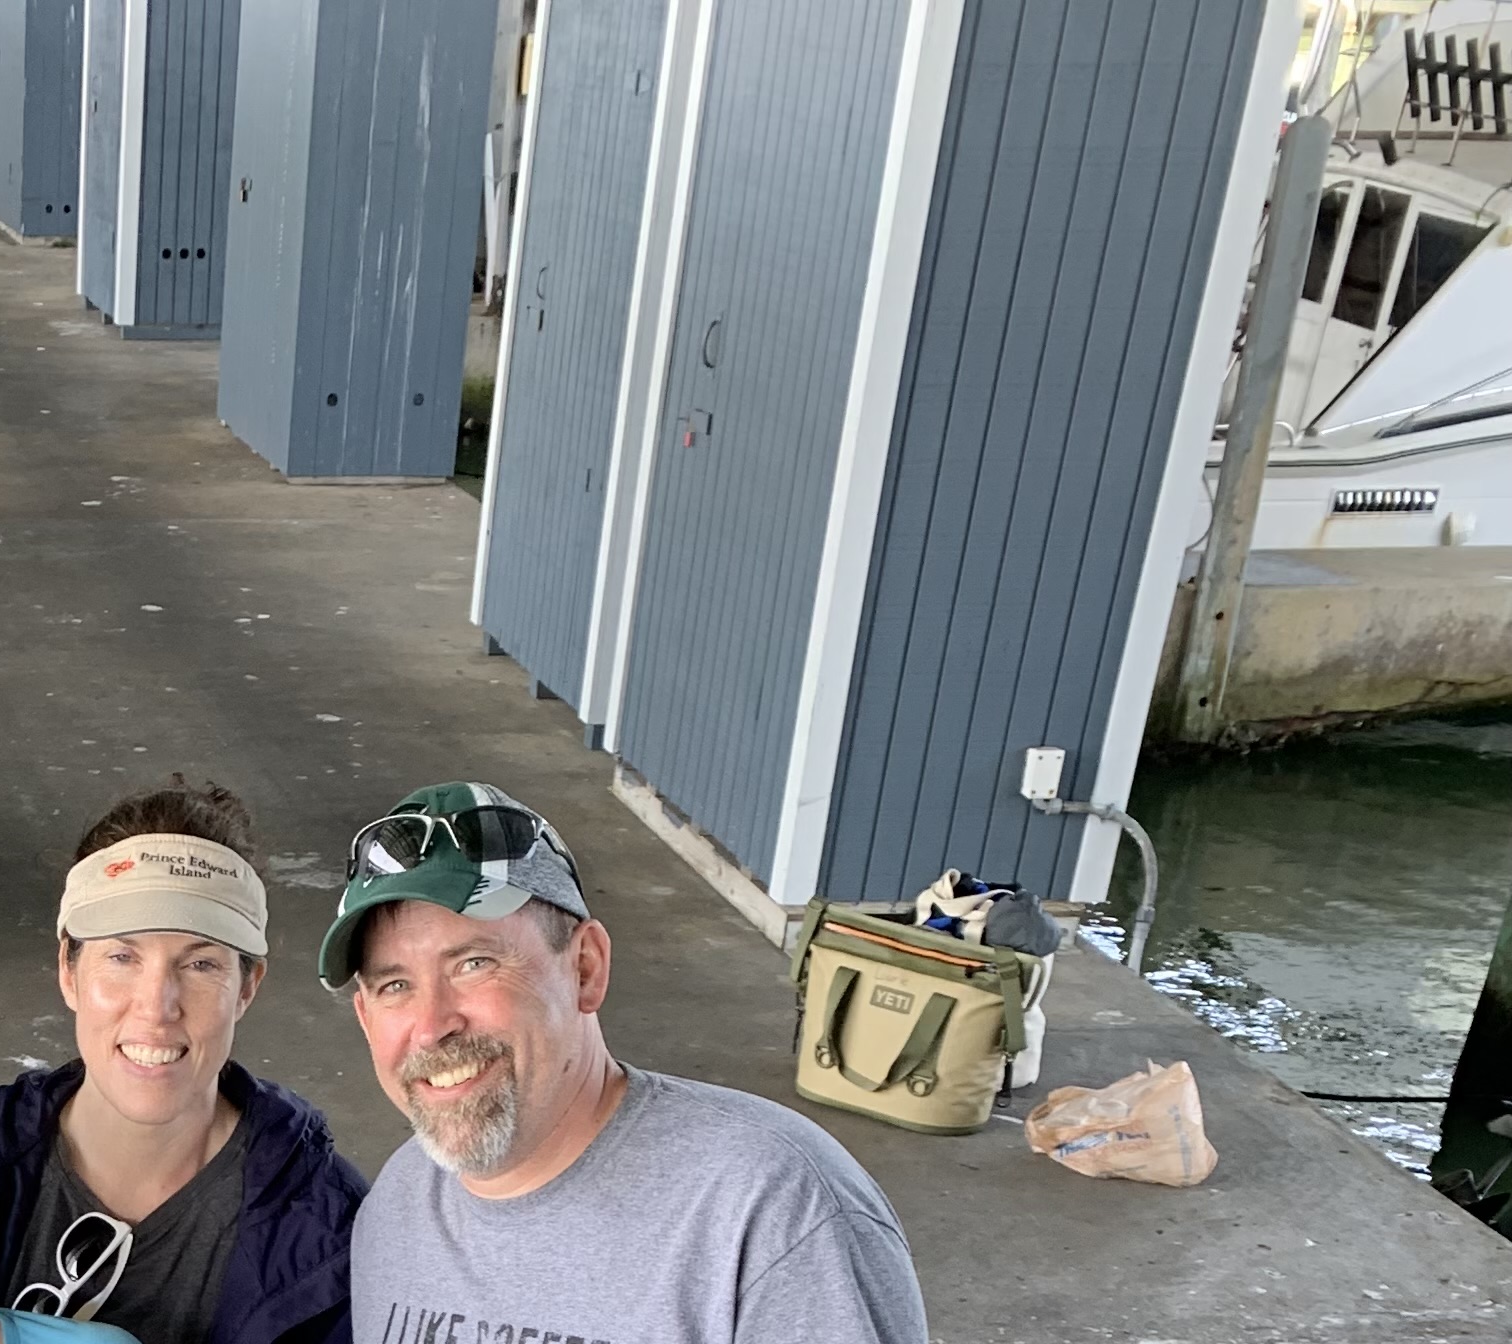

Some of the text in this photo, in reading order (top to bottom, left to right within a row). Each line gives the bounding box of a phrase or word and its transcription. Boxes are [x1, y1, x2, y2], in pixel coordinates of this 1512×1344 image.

[140, 852, 238, 878] Prince Edward
[169, 865, 211, 879] Island
[876, 989, 911, 1010] YETI
